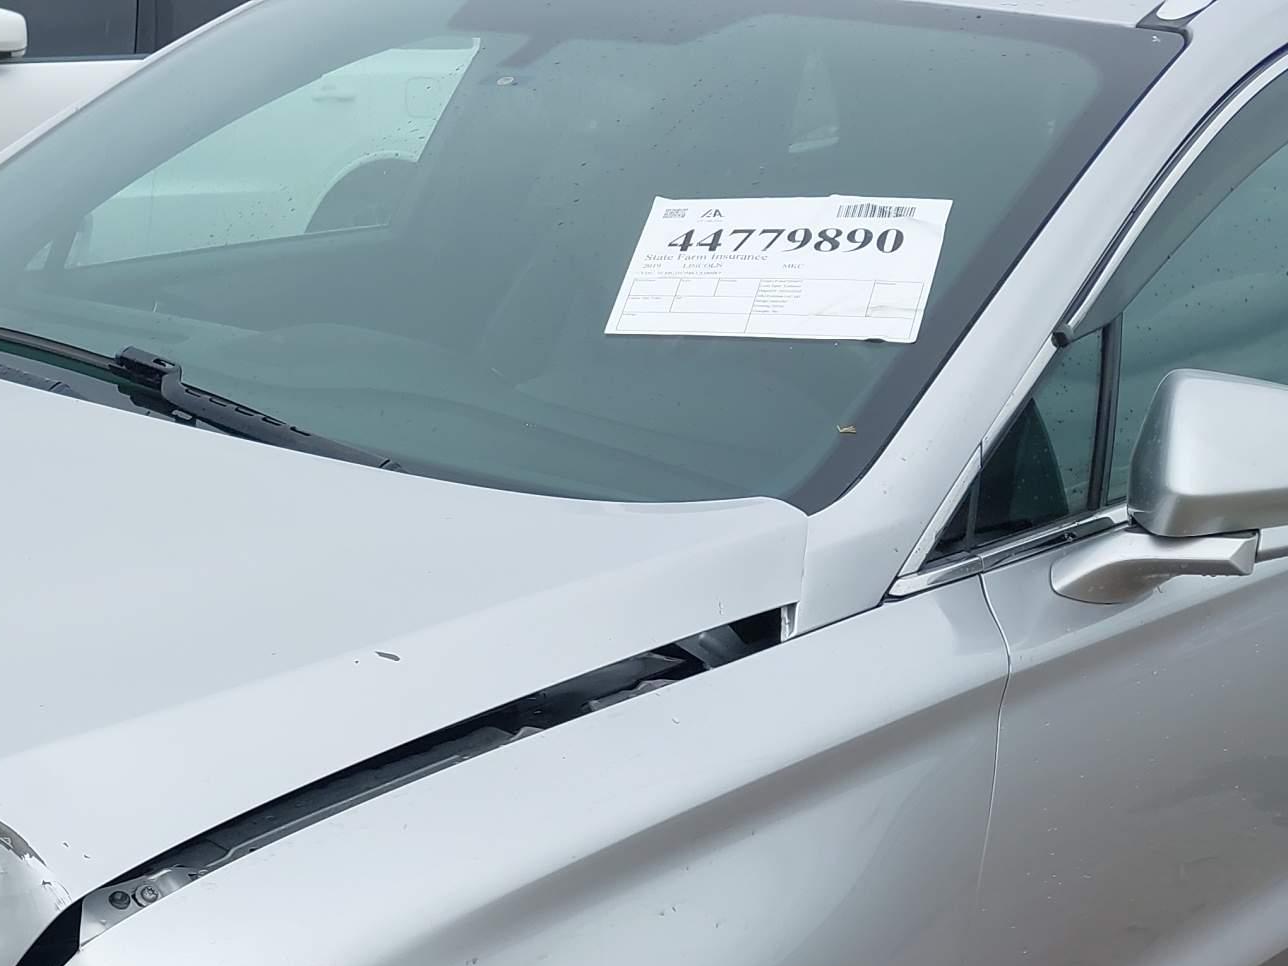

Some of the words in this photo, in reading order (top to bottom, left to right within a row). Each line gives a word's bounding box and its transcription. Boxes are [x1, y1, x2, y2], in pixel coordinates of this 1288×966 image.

[667, 228, 904, 253] 44779890
[644, 253, 673, 261] State
[677, 253, 707, 261] Farm
[711, 253, 768, 261] Insurance
